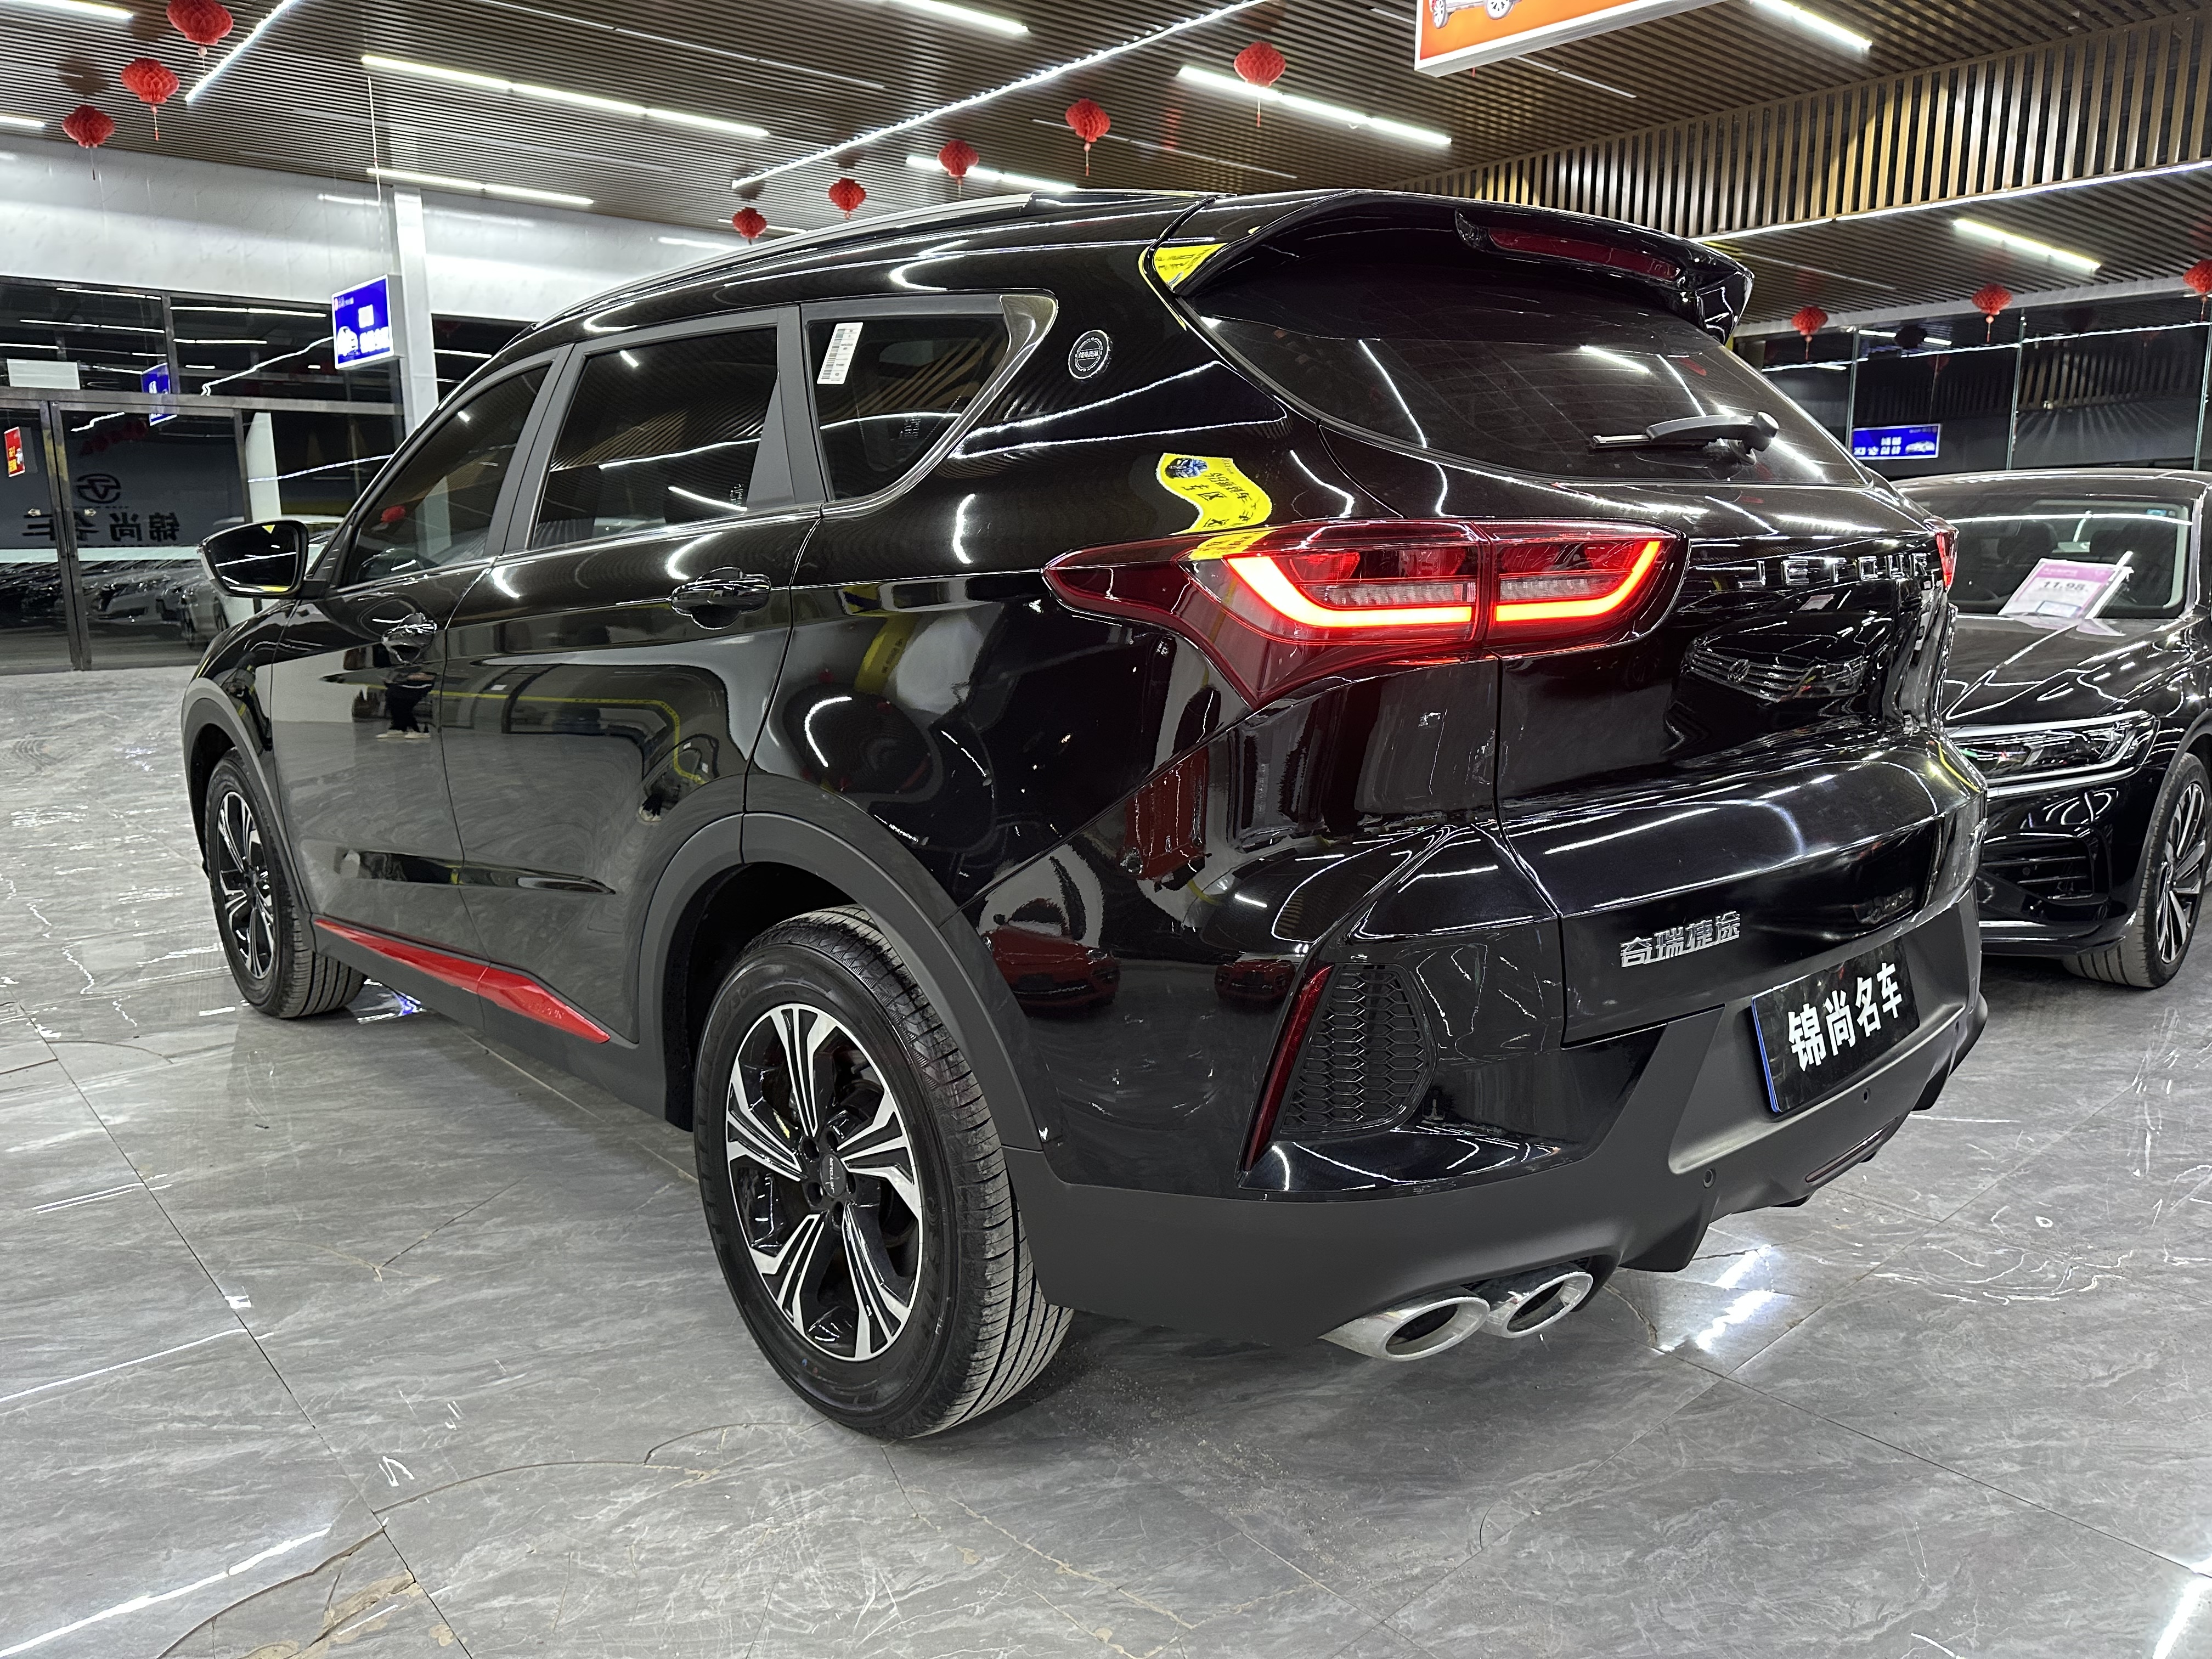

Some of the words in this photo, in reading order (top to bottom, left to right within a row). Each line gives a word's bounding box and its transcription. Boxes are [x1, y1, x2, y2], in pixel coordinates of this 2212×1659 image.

[1737, 552, 1928, 589] JETOUR
[1620, 911, 1741, 968] 奇瑞捷途
[1788, 962, 1903, 1071] 锦尚名车
